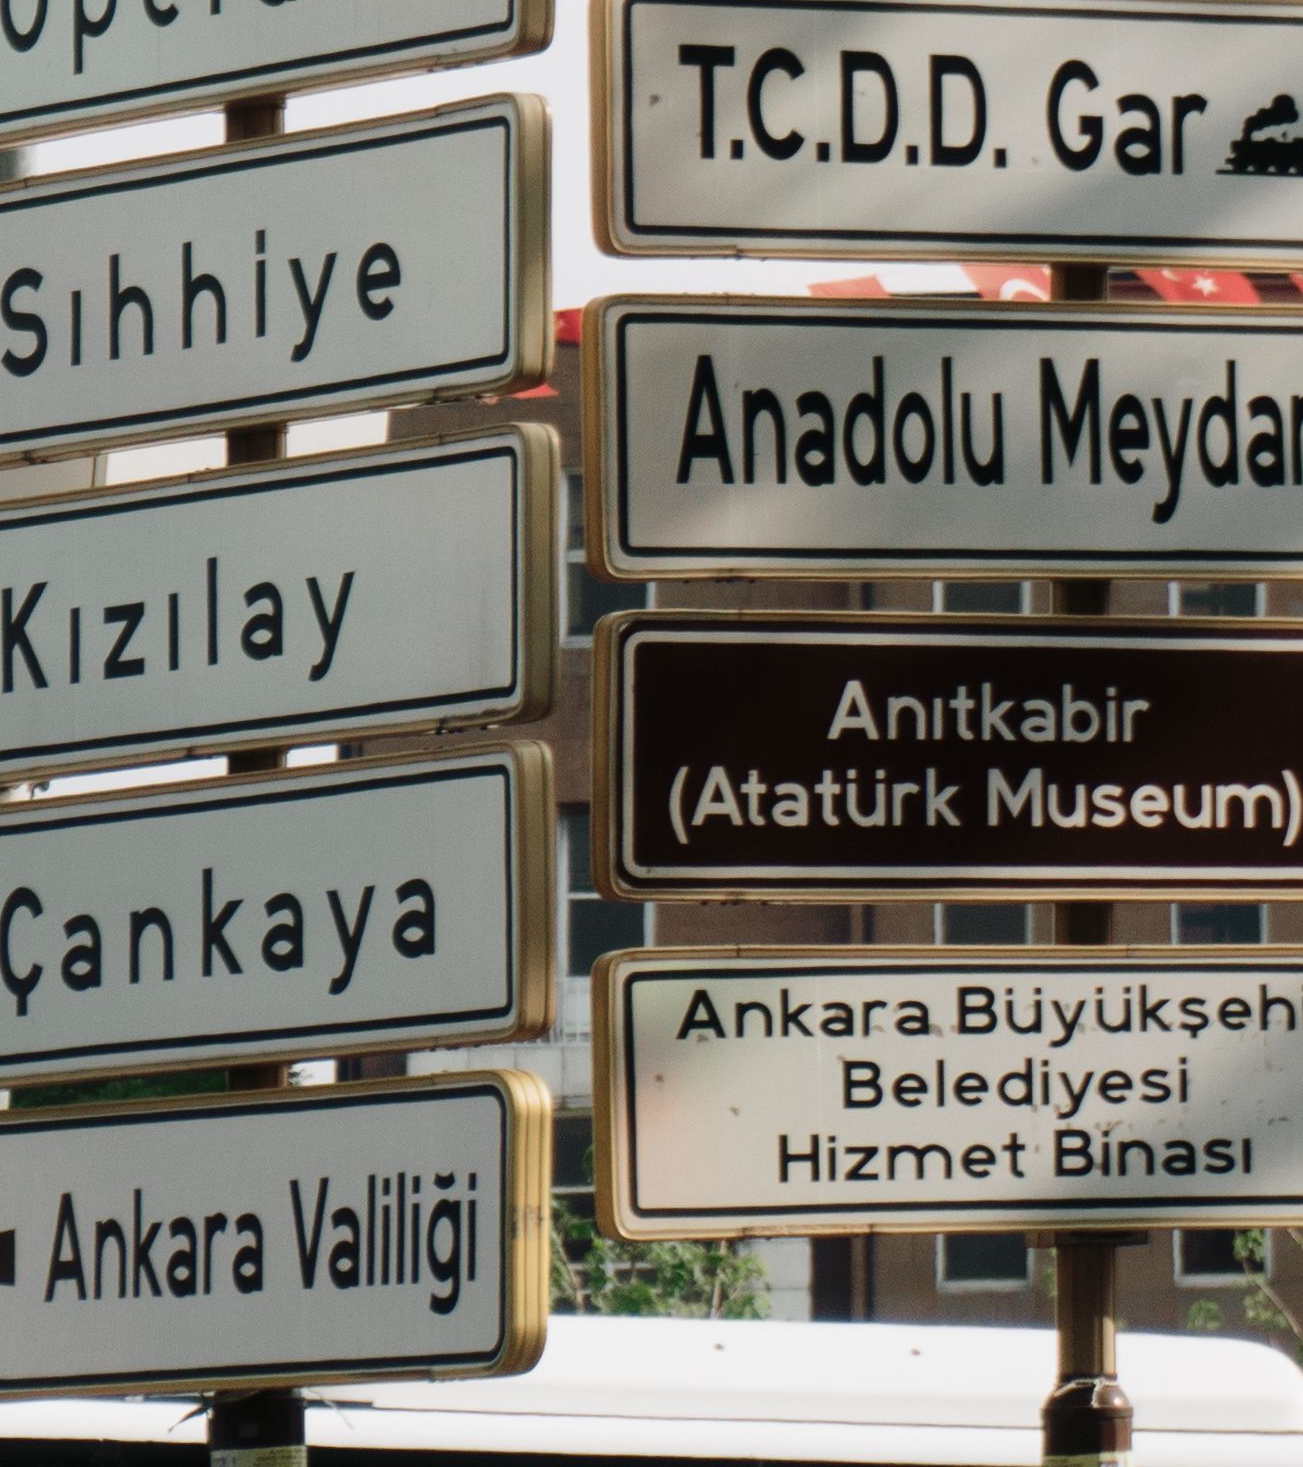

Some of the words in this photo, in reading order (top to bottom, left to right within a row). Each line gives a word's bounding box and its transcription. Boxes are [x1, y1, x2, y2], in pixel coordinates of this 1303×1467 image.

[678, 44, 1006, 168] T.C.D.D.
[1048, 60, 1207, 176] Gar
[0, 229, 401, 378] Sıhhiye
[677, 355, 1004, 486] Anadolu
[0, 557, 355, 694] Kızılay
[828, 680, 1149, 742] Anıtkabir
[670, 766, 960, 844] (Atatürk
[989, 769, 1302, 846] Museum)
[676, 989, 931, 1041] Ankara
[843, 1057, 1188, 1119] Belediyesi
[780, 1133, 1025, 1182] Hizmet
[1056, 1130, 1252, 1176] Binası
[45, 1189, 263, 1302] Ankara
[290, 1172, 476, 1315] Valiliği
